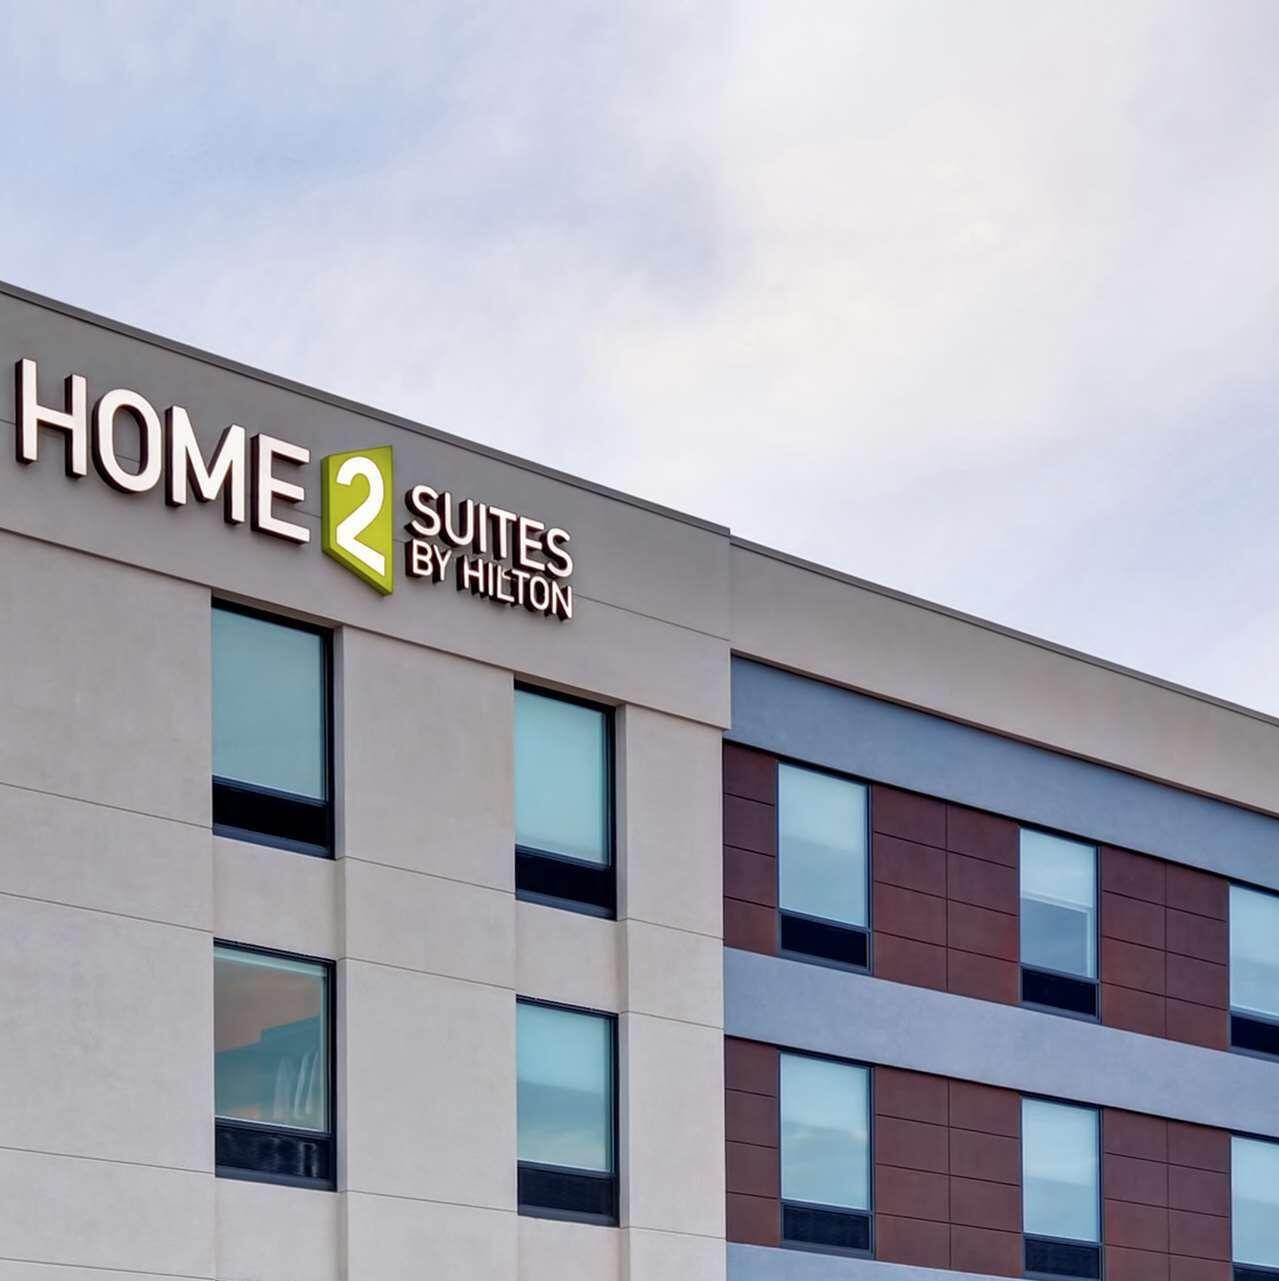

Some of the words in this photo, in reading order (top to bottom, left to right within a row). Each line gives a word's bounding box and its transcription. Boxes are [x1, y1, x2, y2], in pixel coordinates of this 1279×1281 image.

[16, 358, 310, 543] HOME
[336, 456, 385, 567] 2
[407, 484, 574, 579] SUITES
[407, 540, 451, 581] BY
[458, 558, 573, 619] HILTON
